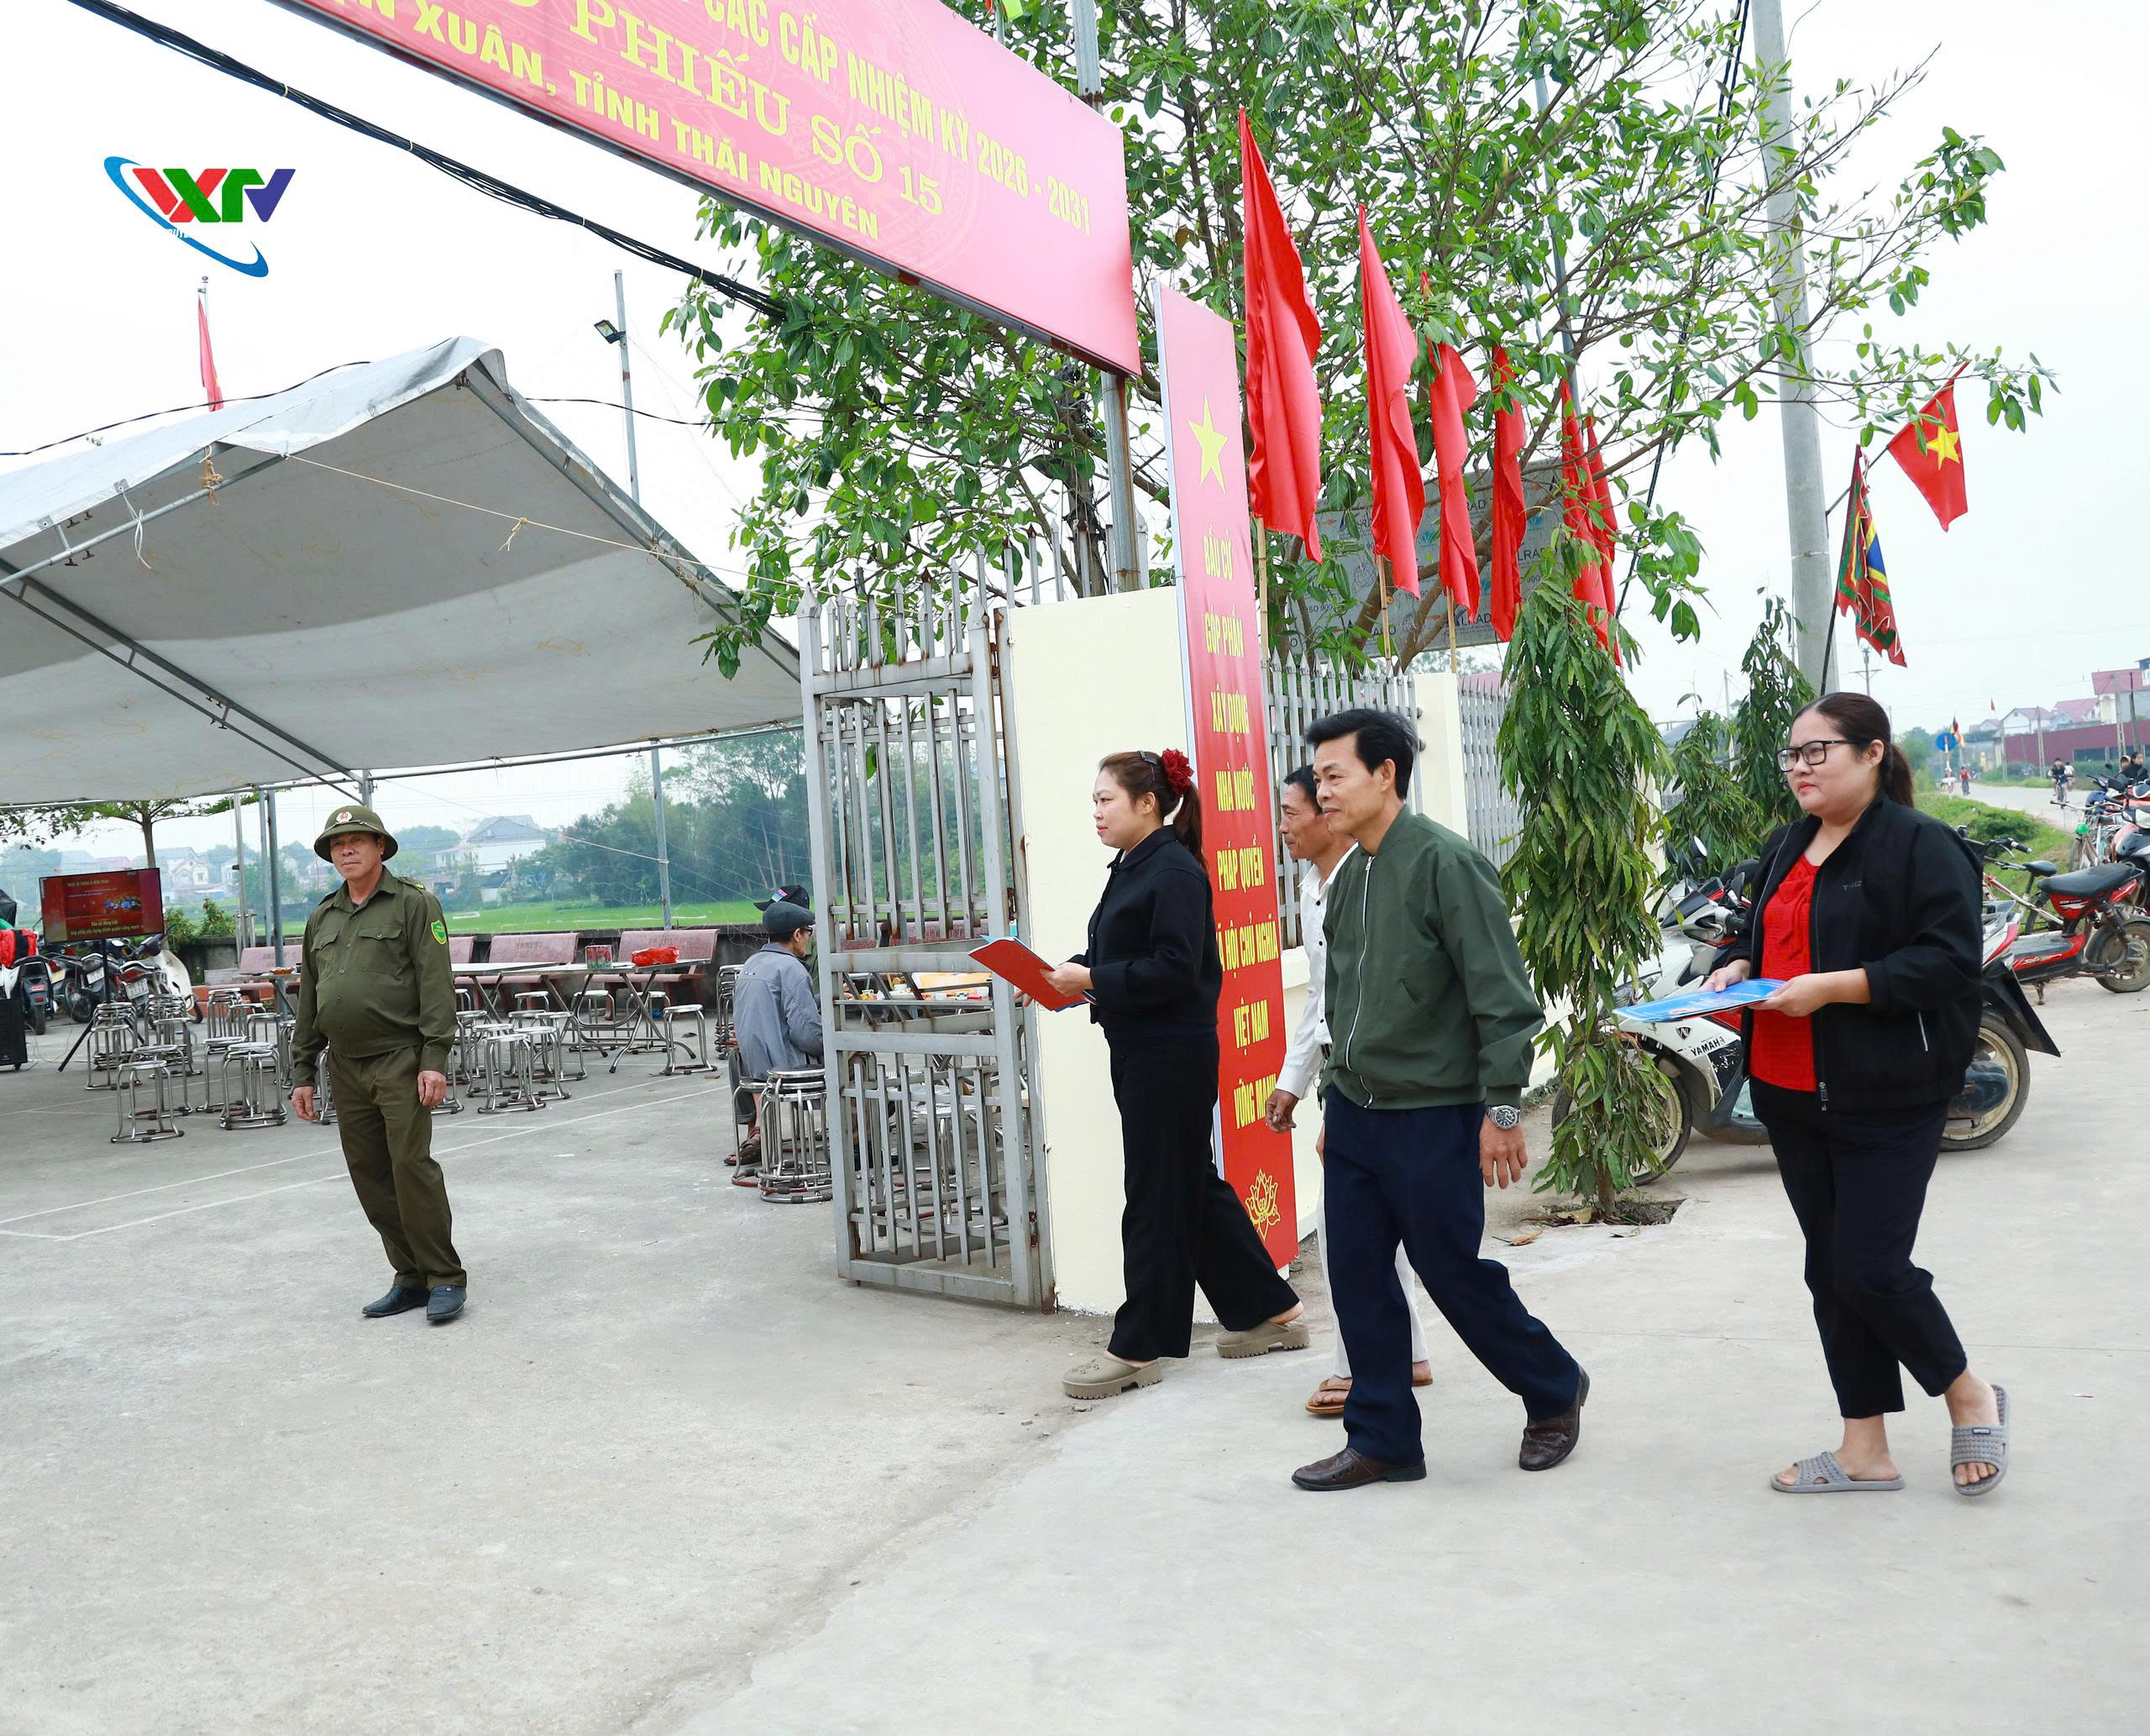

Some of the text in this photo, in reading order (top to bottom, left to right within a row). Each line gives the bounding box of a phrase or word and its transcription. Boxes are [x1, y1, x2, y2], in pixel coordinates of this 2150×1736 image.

[569, 0, 943, 216] PHIẾU SỐ 15
[779, 12, 838, 85] CẤP
[847, 50, 934, 144] NHIỆM
[940, 107, 969, 162] KỲ
[977, 131, 1029, 198] 2026
[1047, 175, 1091, 235] 2031
[569, 69, 660, 141] TỈNH
[671, 114, 749, 182] THÁI
[760, 160, 878, 239] NGUYÊN
[1204, 604, 1245, 658] GÓP PHẦN
[1210, 682, 1250, 743] XÂY DỰNG
[1216, 762, 1255, 811] NHÀ NƯỚC
[1217, 833, 1264, 893] PHÁP QUYỀN
[1216, 910, 1278, 979] Ã HỘI CHỦ NGHĨA
[1234, 997, 1270, 1056] VIỆT NAM
[1234, 1078, 1256, 1129] VỮNG
